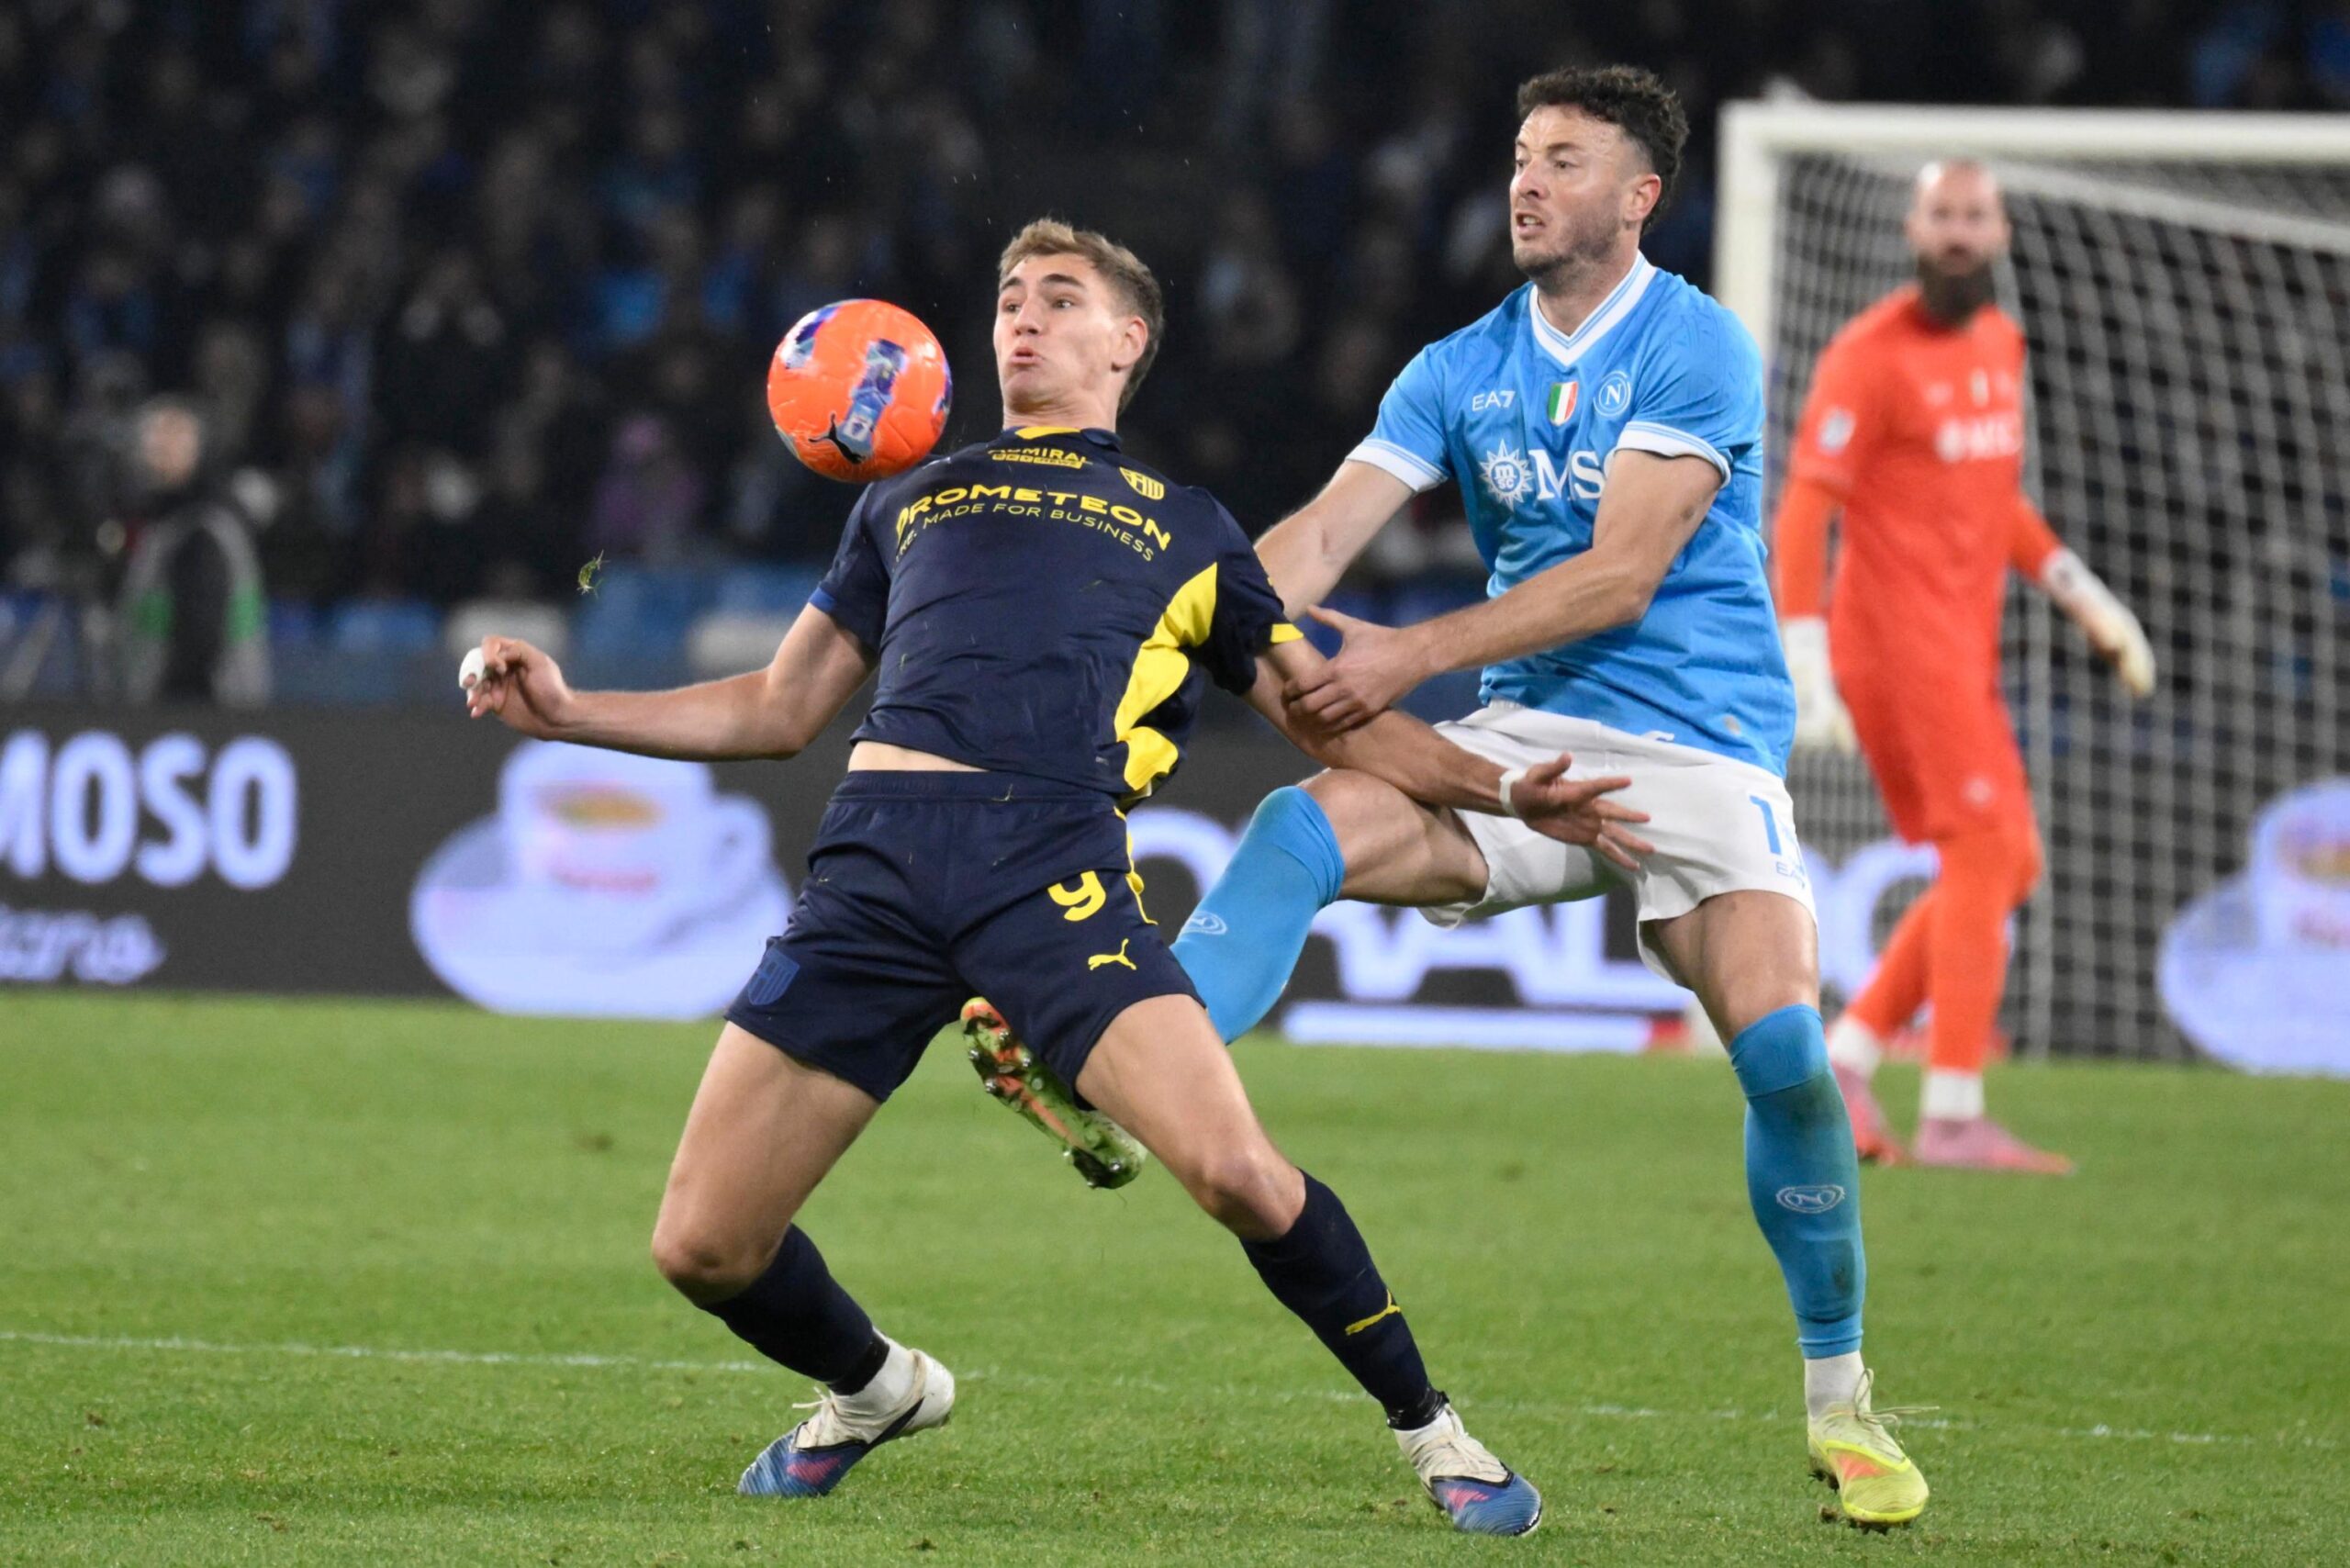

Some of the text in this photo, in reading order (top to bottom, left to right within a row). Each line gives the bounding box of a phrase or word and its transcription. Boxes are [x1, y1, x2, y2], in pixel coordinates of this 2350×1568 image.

[1472, 390, 1516, 411] EA7
[1528, 449, 1614, 501] MS
[923, 503, 985, 530] MADE
[992, 503, 1041, 517] FOR
[1049, 509, 1154, 562] BUSINESS
[1047, 870, 1106, 921] 9
